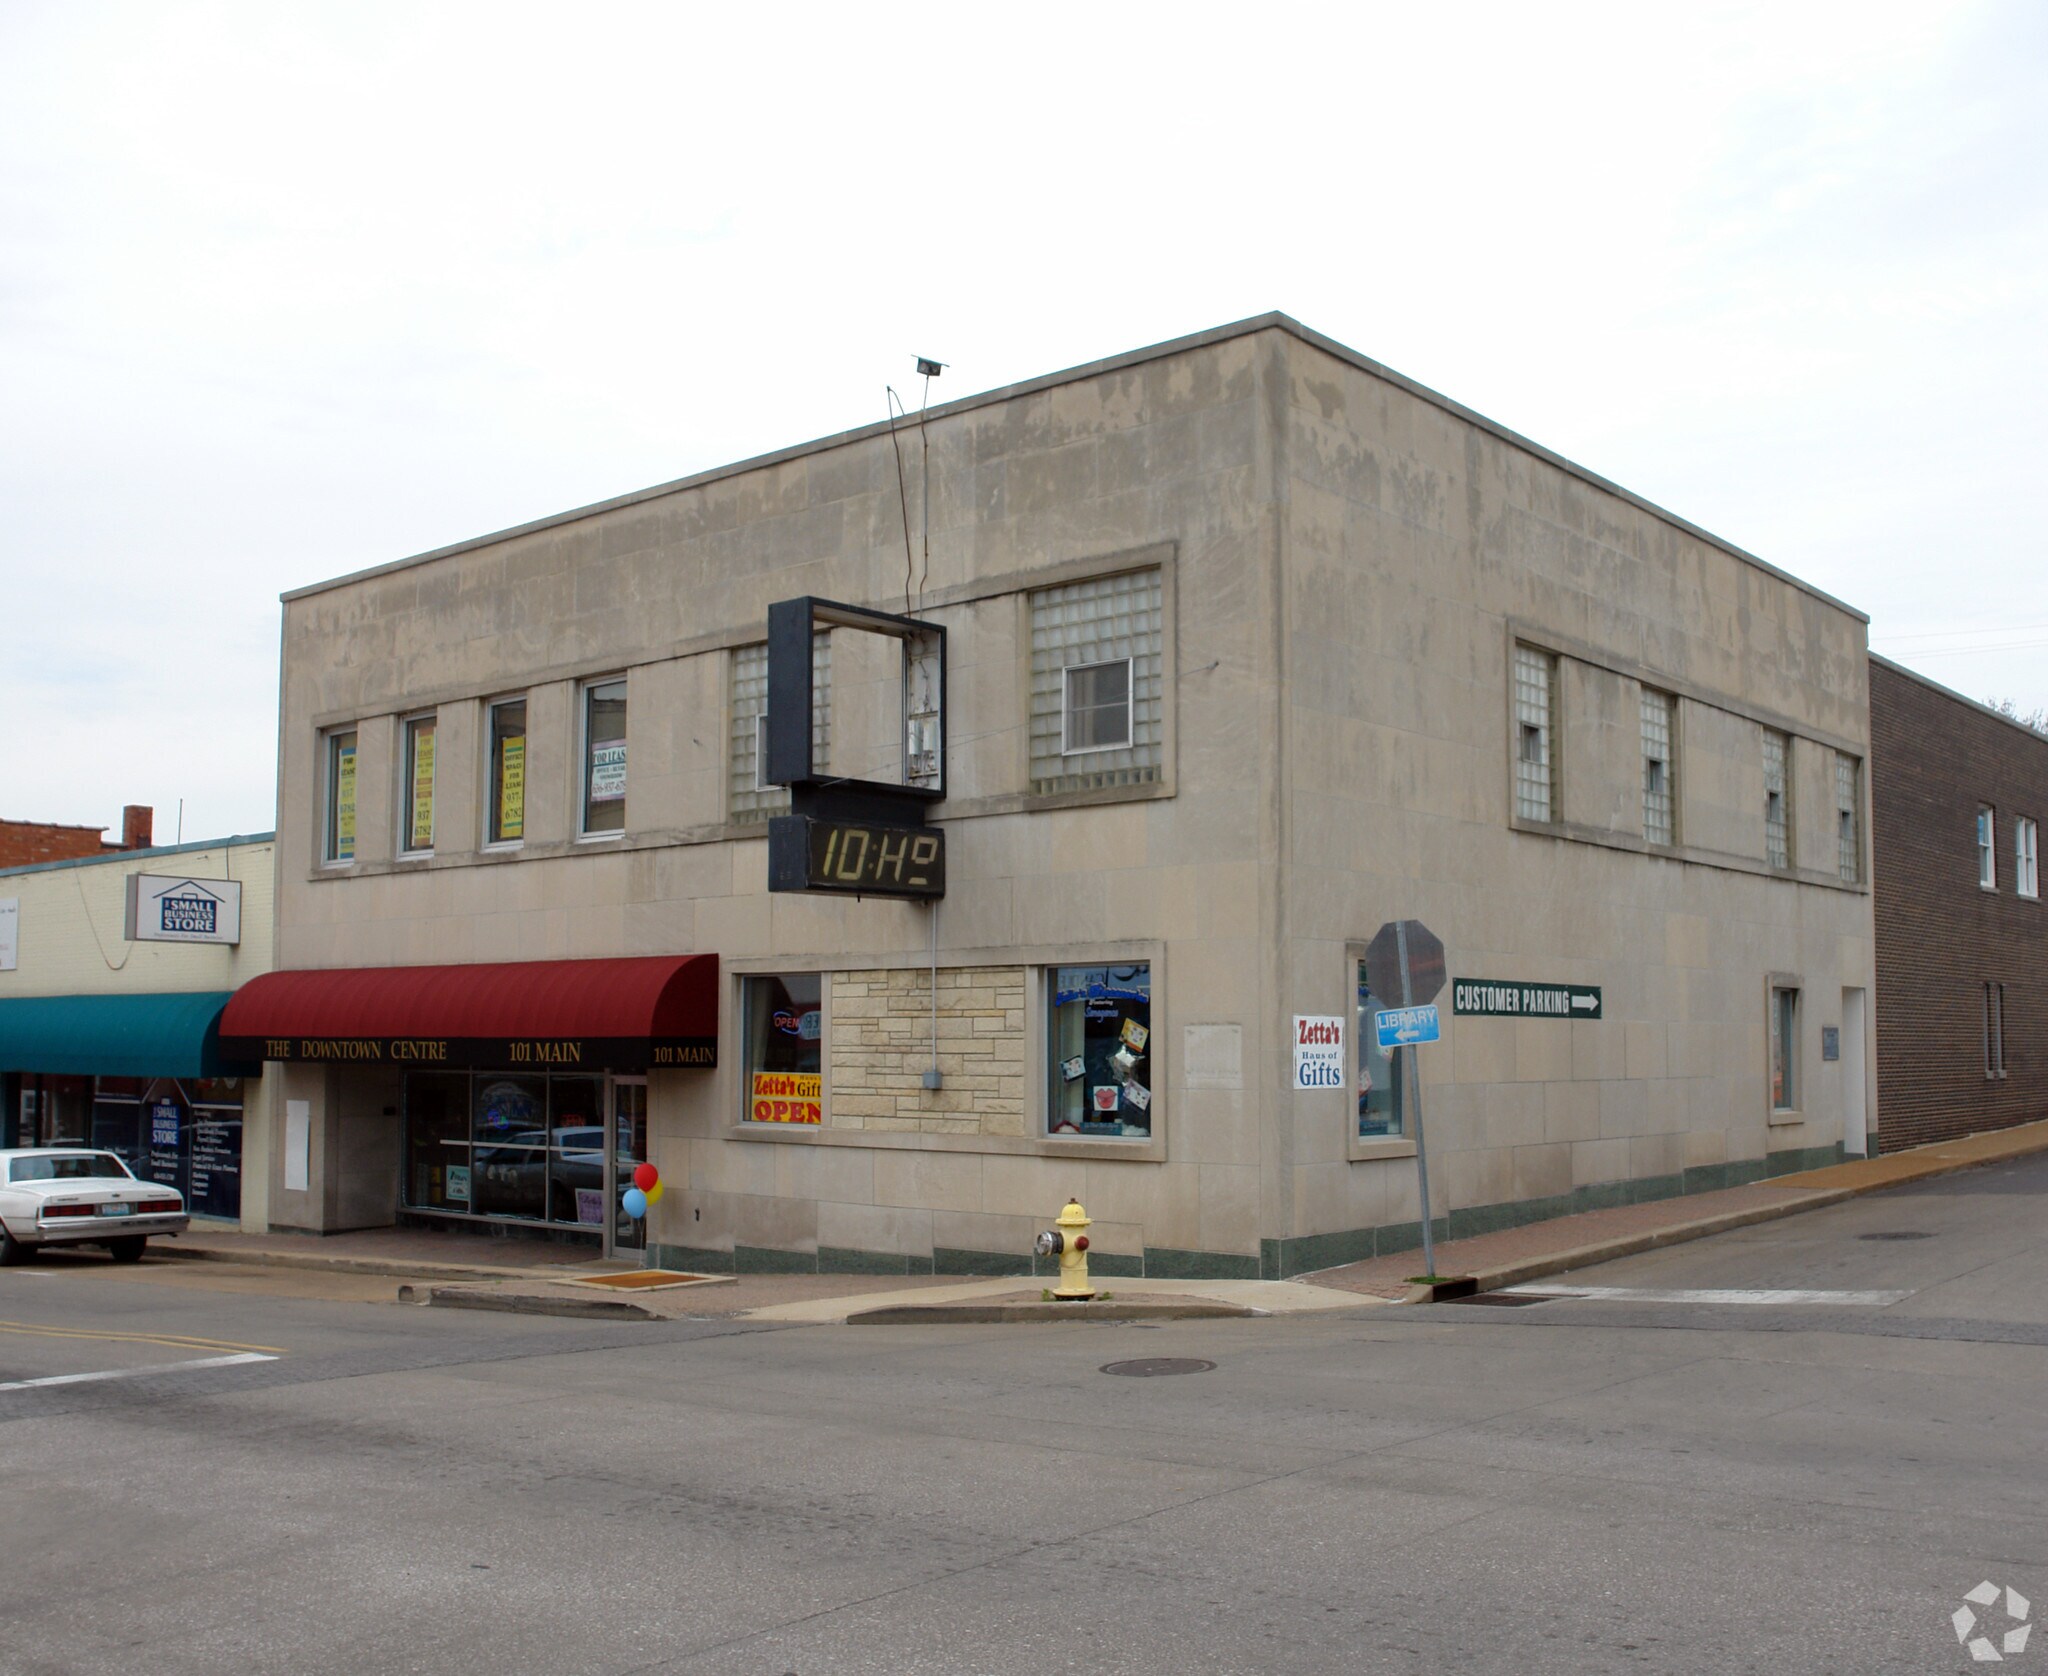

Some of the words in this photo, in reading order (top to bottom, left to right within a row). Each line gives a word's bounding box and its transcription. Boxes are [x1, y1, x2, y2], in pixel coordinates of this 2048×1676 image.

[164, 909, 213, 920] BUSINESS
[171, 900, 213, 912] SMALL
[164, 918, 213, 931] STORE
[1456, 985, 1520, 1012] CUSTOMER
[1523, 989, 1570, 1014] PARKING
[774, 1016, 800, 1028] OPEN
[1378, 1008, 1436, 1029] LIBRARY
[1299, 1019, 1340, 1045] Zetta's
[265, 1040, 290, 1057] THE
[302, 1040, 382, 1059] DOWNTOWN
[390, 1041, 448, 1060] CENTRE
[509, 1042, 532, 1062] 101
[535, 1042, 581, 1062] MAIN
[654, 1047, 673, 1063] 101
[677, 1047, 715, 1063] MAIN
[1302, 1051, 1326, 1060] Haus
[1328, 1051, 1337, 1060] of
[1299, 1060, 1340, 1086] Gifts
[755, 1075, 795, 1095] Zetta's
[157, 1106, 177, 1118] SMALL
[755, 1101, 821, 1123] OPEN
[152, 1130, 177, 1145] STORE
